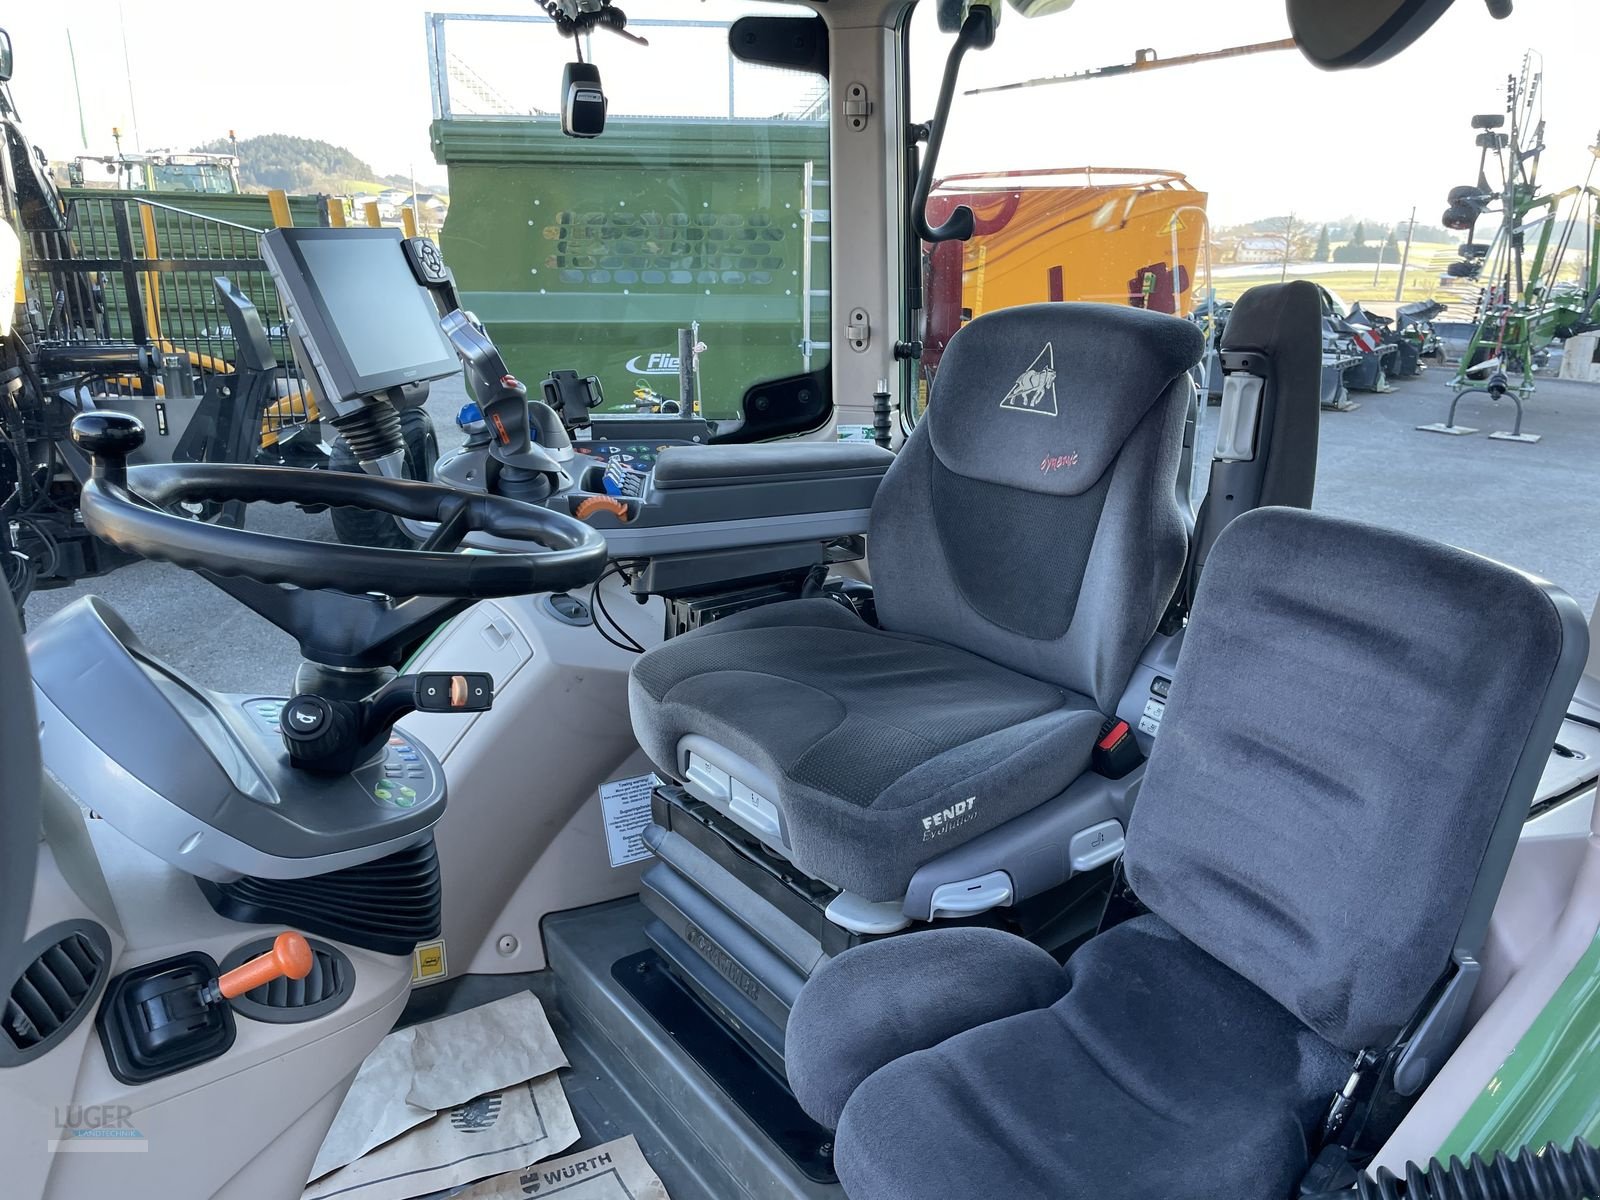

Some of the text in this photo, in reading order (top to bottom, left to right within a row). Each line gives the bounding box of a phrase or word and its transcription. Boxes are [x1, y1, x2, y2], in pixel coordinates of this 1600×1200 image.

[647, 353, 680, 368] Flie
[922, 796, 976, 830] FENDT
[922, 811, 977, 842] Evolution
[543, 1152, 613, 1185] WÜRTH
